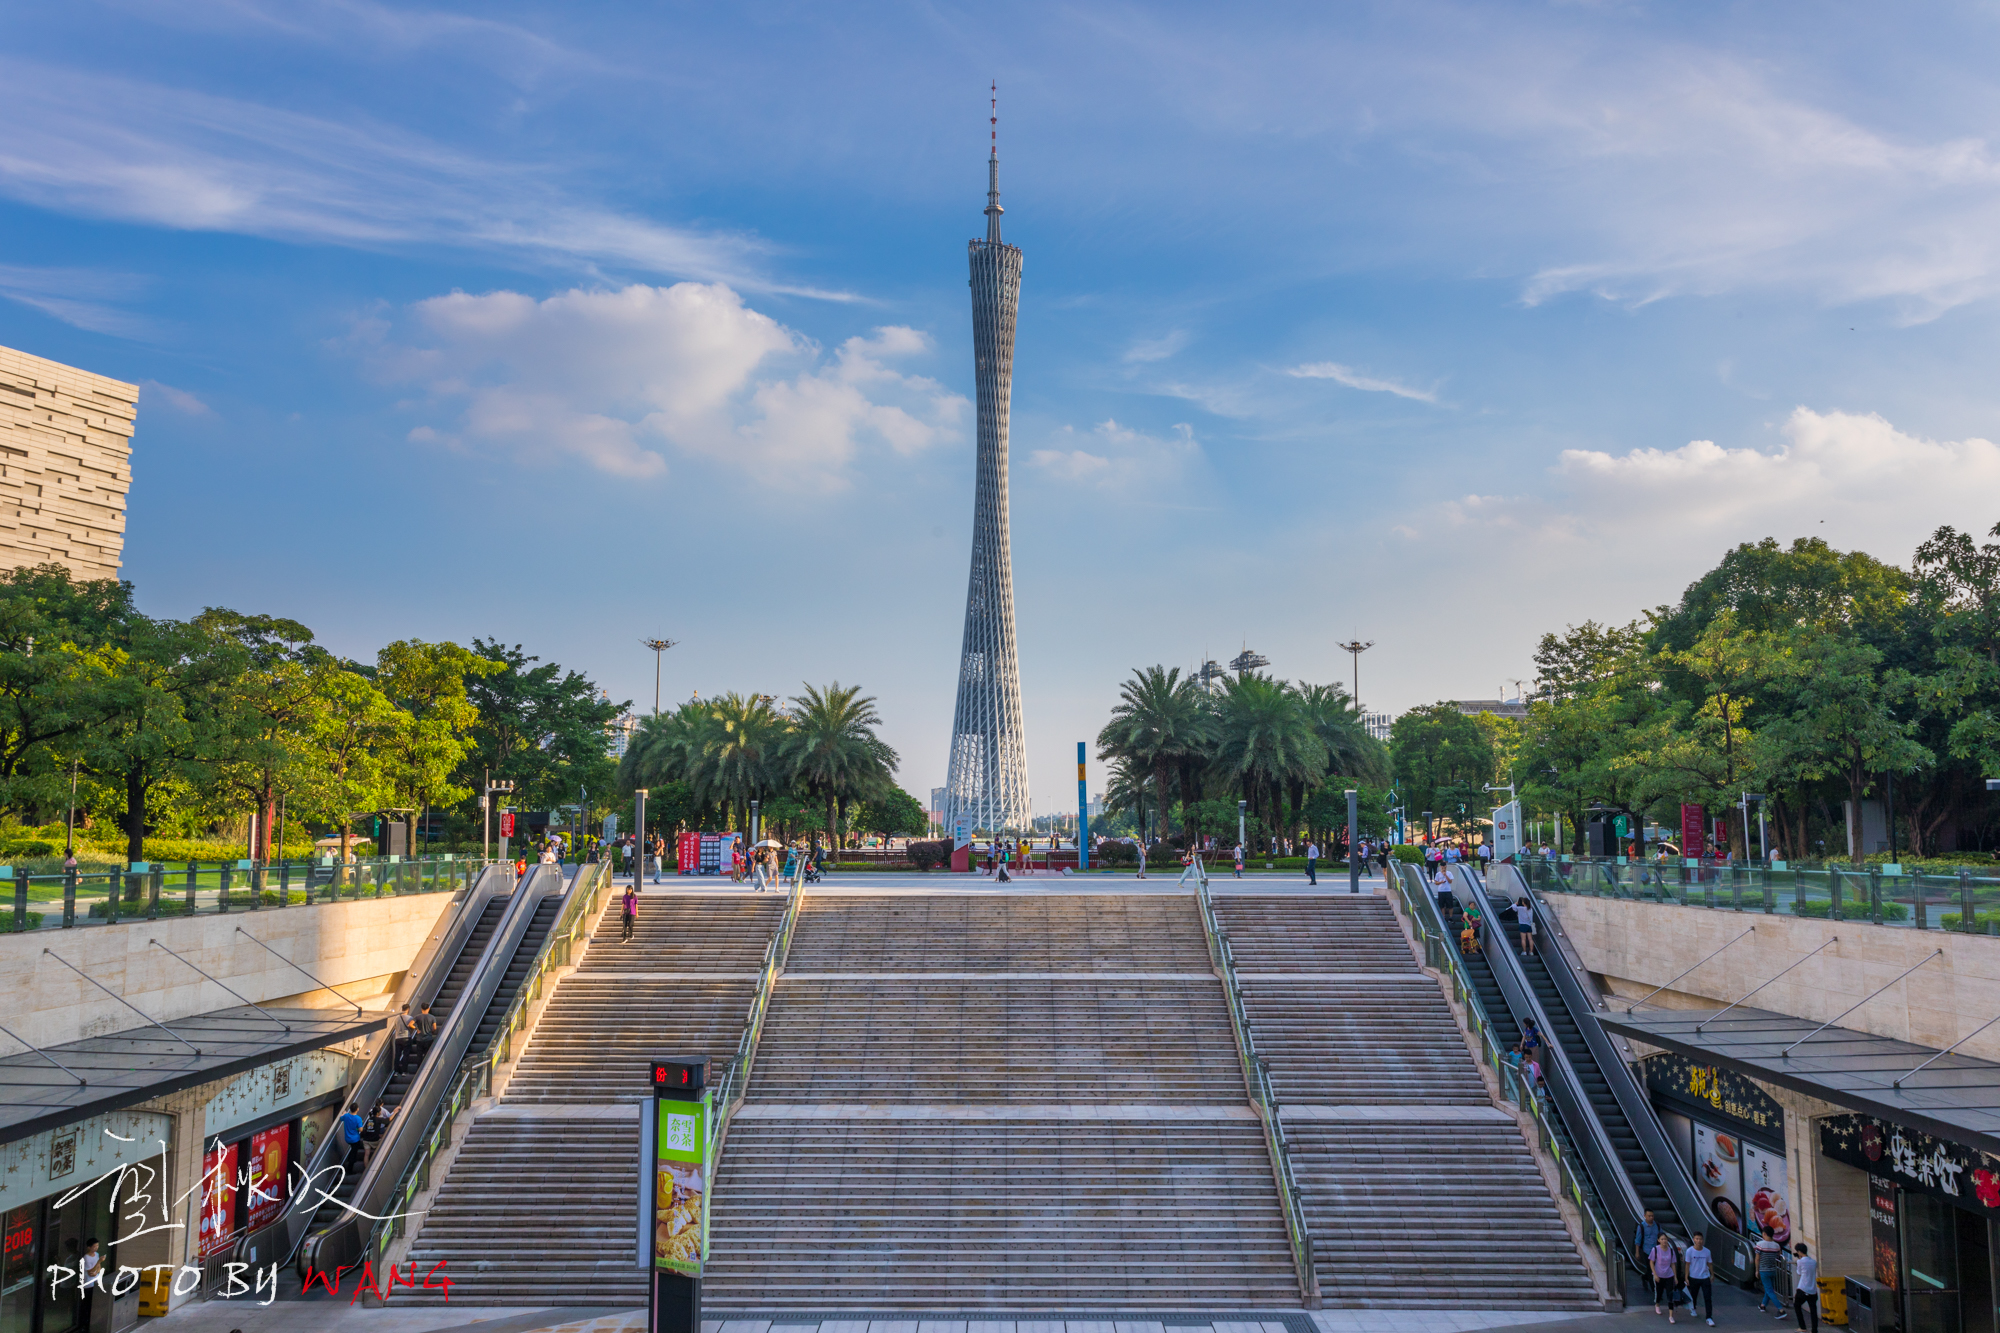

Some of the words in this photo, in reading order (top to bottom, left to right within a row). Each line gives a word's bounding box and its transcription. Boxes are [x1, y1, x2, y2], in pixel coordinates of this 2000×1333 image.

[656, 1067, 667, 1082] 份
[1891, 1129, 1963, 1197] 蛙来哒
[5, 1227, 33, 1253] 2018
